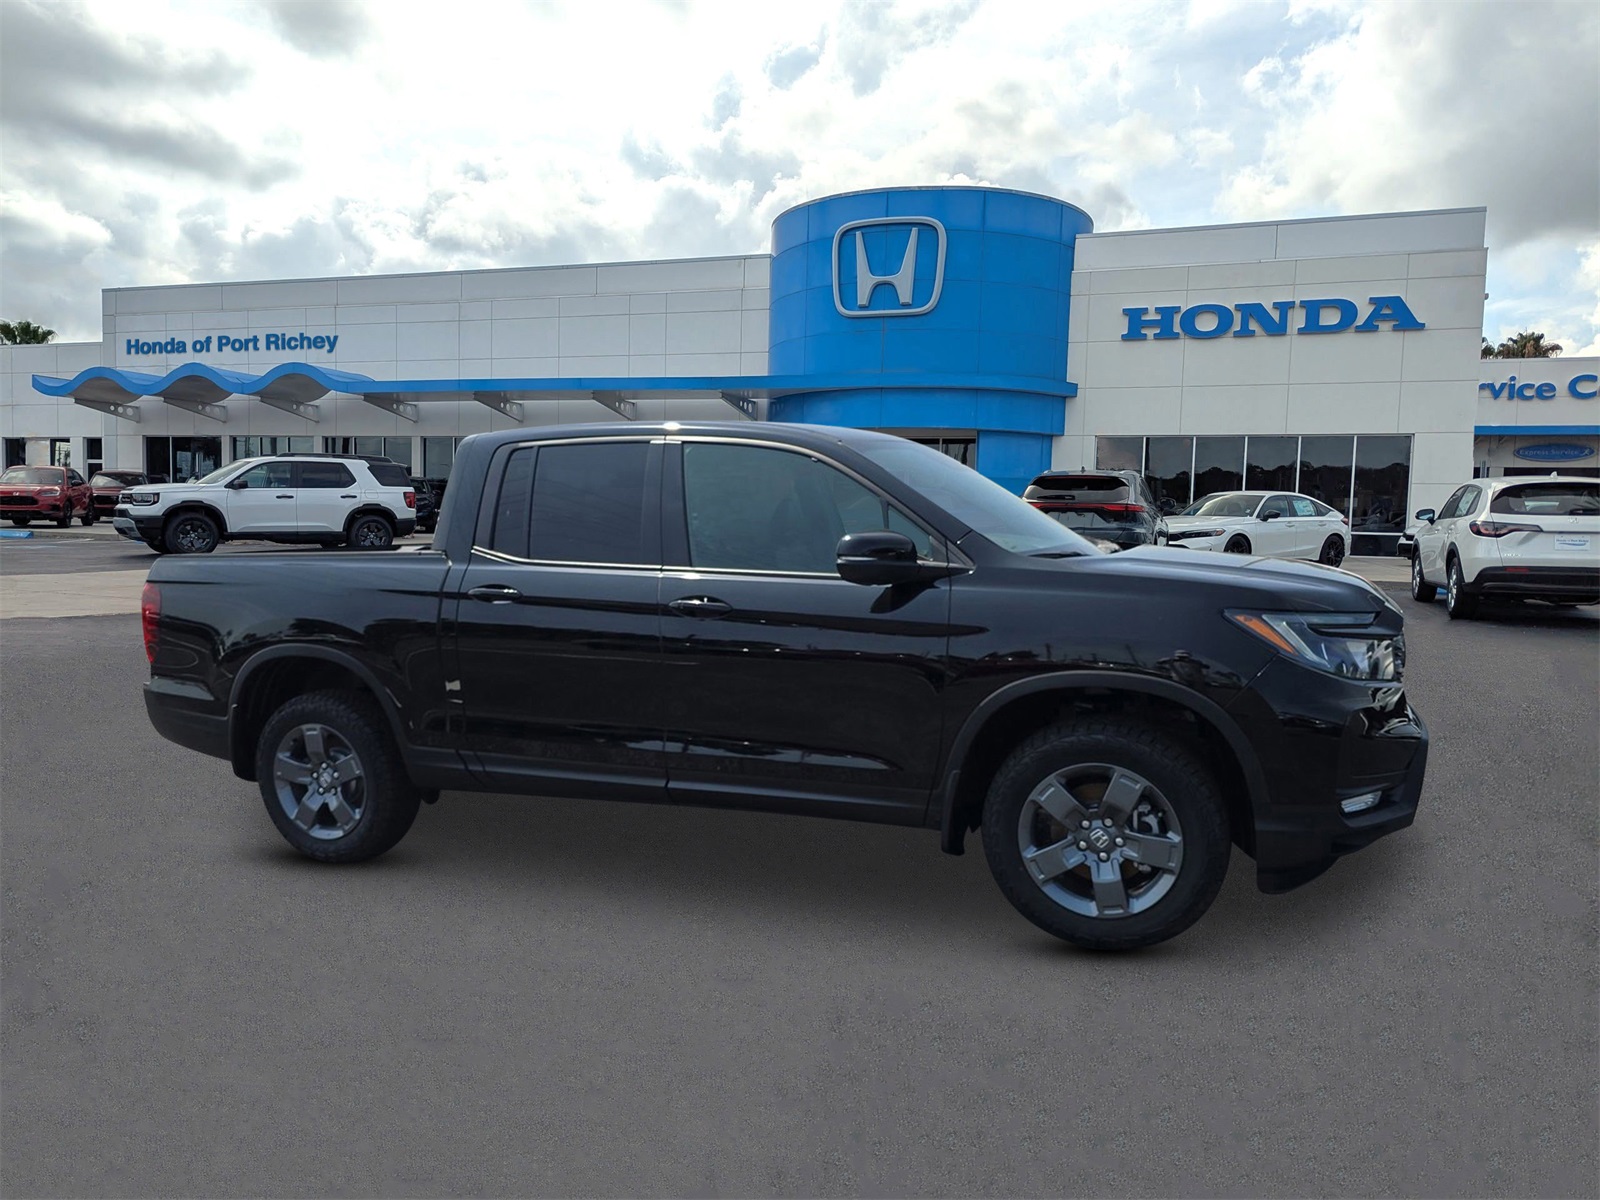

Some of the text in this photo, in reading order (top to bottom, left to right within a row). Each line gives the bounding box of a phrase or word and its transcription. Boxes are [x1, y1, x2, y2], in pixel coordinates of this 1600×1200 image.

[1121, 295, 1426, 341] HONDA
[126, 332, 339, 355] Honda of Port Richey
[1568, 374, 1600, 400] C
[1519, 447, 1580, 457] Express Service
